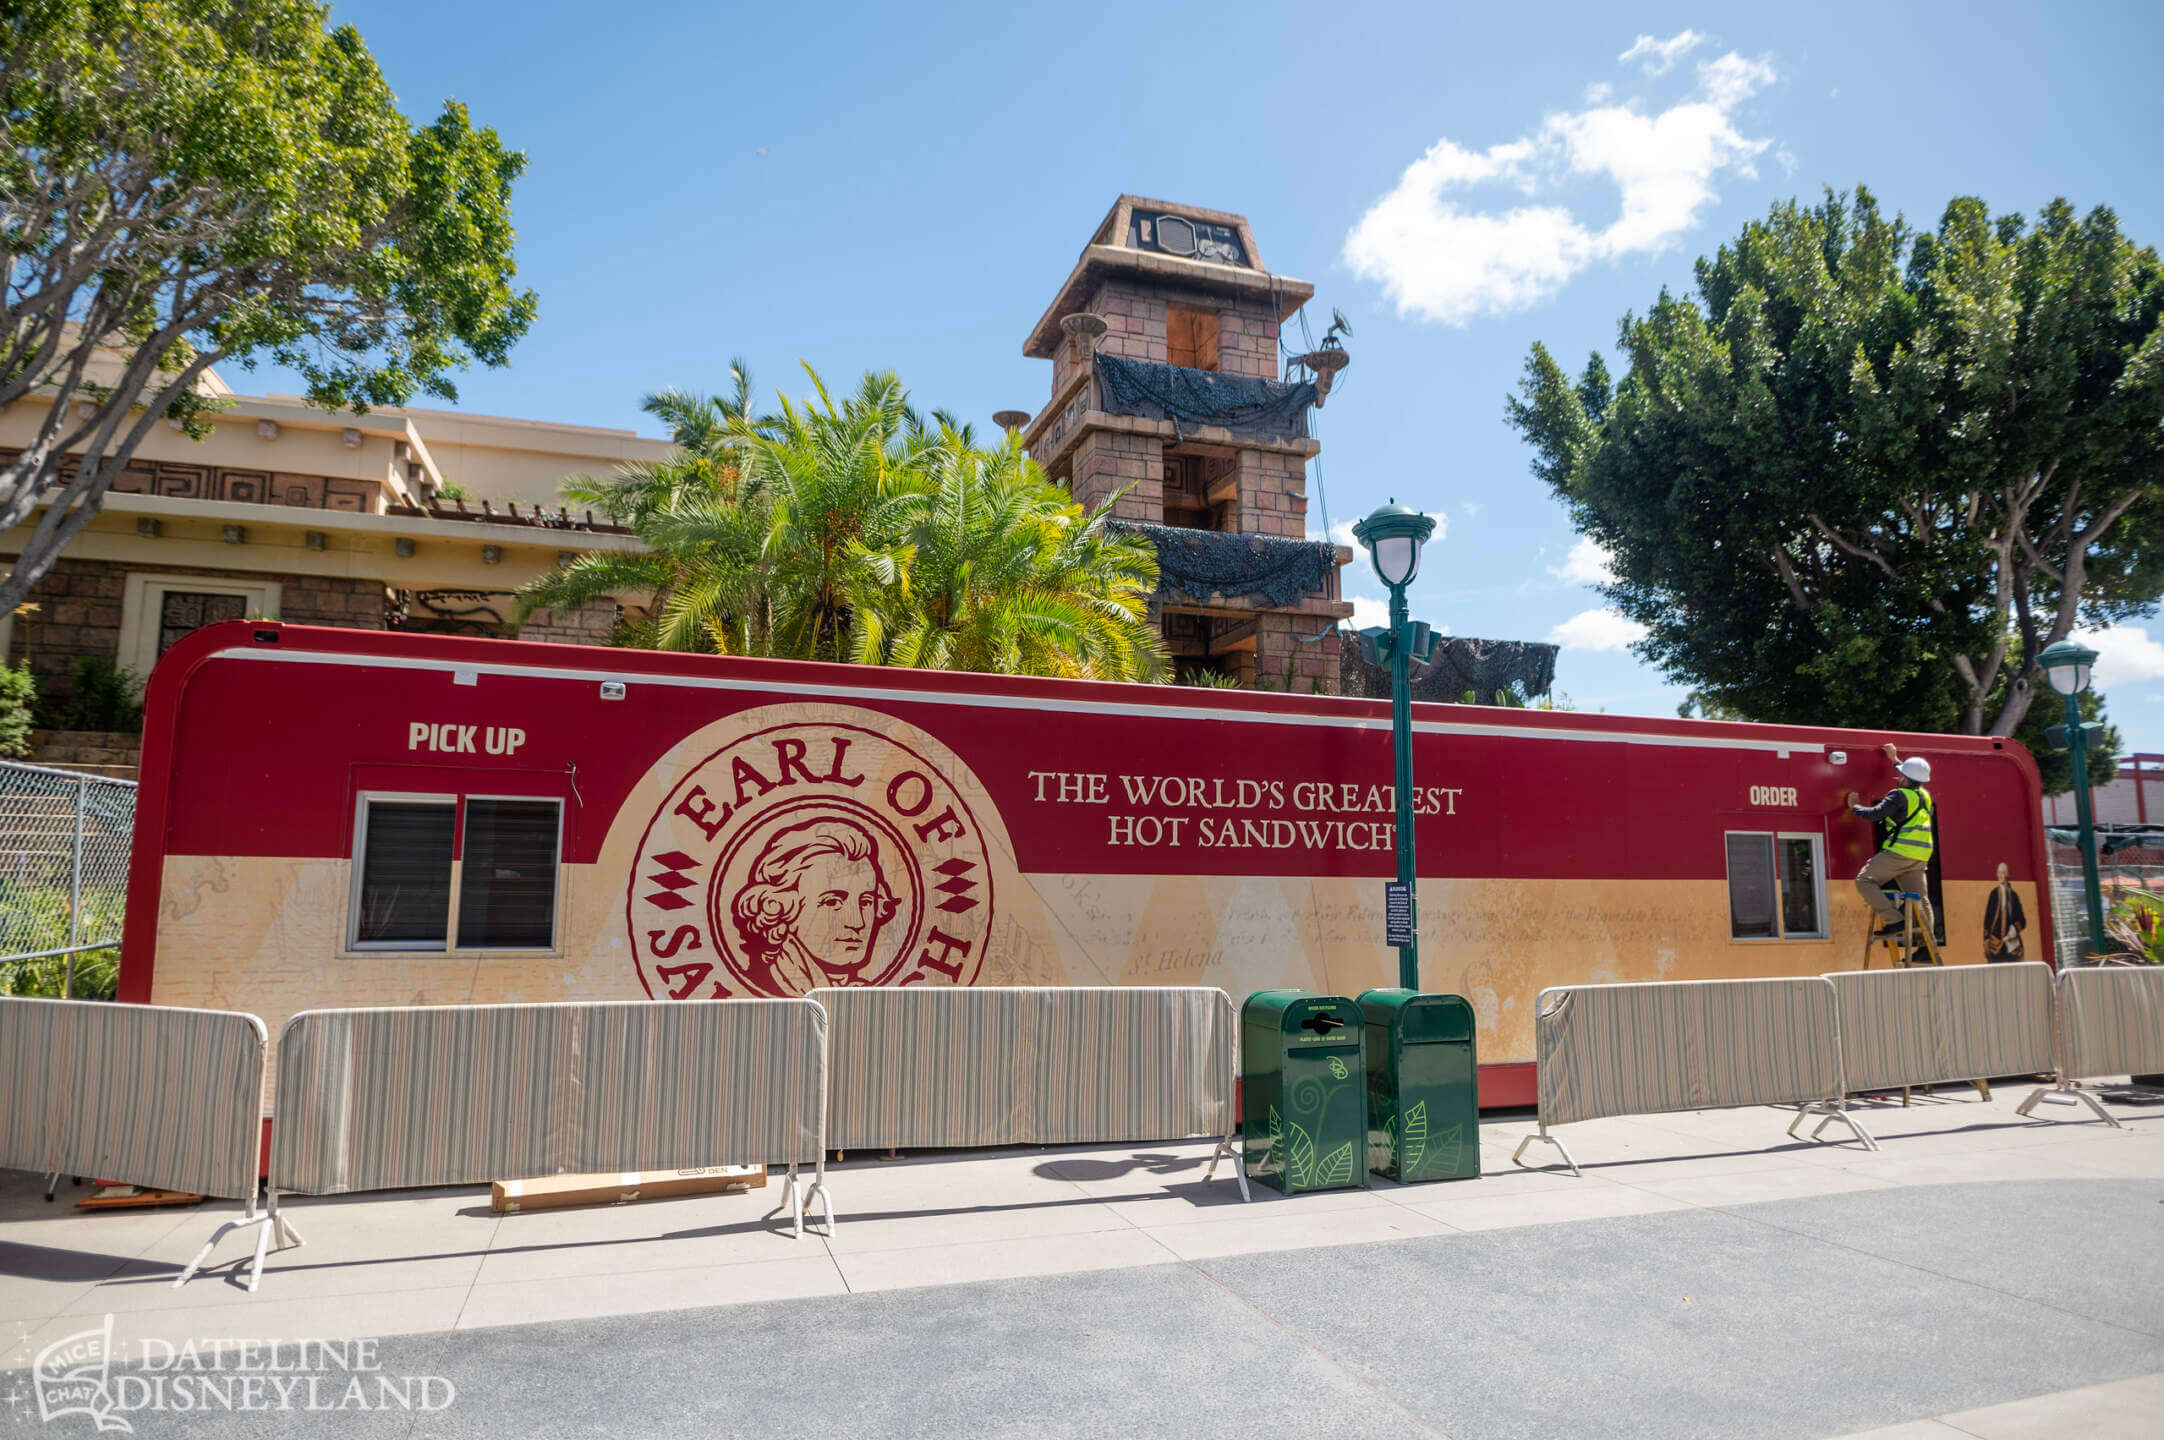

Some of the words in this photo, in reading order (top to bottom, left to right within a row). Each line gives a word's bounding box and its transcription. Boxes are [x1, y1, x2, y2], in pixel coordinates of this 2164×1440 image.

[408, 722, 477, 753] PICK
[485, 726, 526, 755] UP
[673, 736, 865, 842] EARL
[887, 770, 966, 844] OF
[1028, 770, 1110, 804] THE
[1119, 775, 1284, 810] WORLD'S
[1293, 782, 1463, 816] GREATEST
[1750, 785, 1799, 807] ORDER
[1107, 815, 1189, 847] HOT
[1198, 817, 1393, 851] SANDWICH
